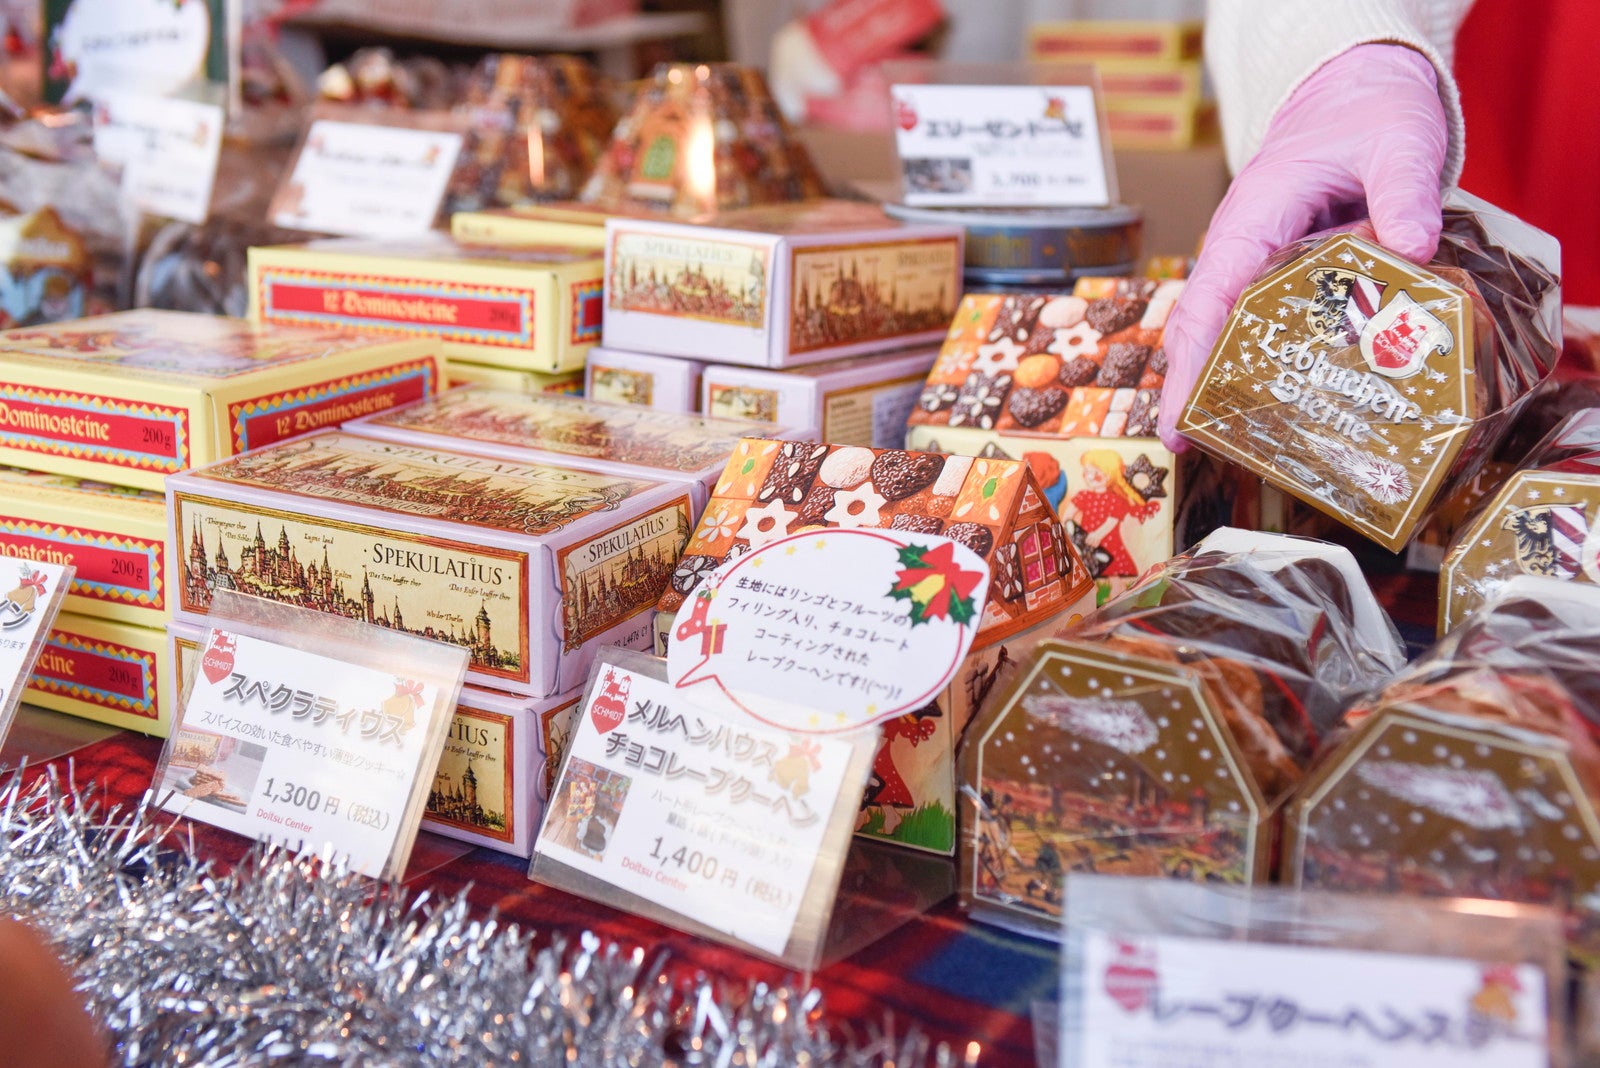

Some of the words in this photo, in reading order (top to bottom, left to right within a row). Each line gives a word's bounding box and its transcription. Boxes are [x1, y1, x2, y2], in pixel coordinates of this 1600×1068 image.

[342, 291, 459, 323] Dominosteine
[276, 416, 291, 436] 12
[294, 392, 397, 430] Dominosteine
[1270, 370, 1371, 443] Sterne
[588, 515, 665, 563] SPEKULATIUS
[373, 543, 503, 586] SPEKULATIUS
[735, 576, 908, 627] 生地にはリンゴとフルーツの
[203, 656, 233, 672] SCHMIDT
[754, 628, 870, 667] コーティングされた
[223, 672, 406, 745] スペクラティウス
[592, 703, 623, 722] SCHMIDT
[628, 699, 778, 768] メルヘンハウス
[256, 808, 284, 825] Doitsu
[284, 816, 313, 834] Center
[621, 855, 654, 878] Doitsu
[654, 869, 689, 892] Center
